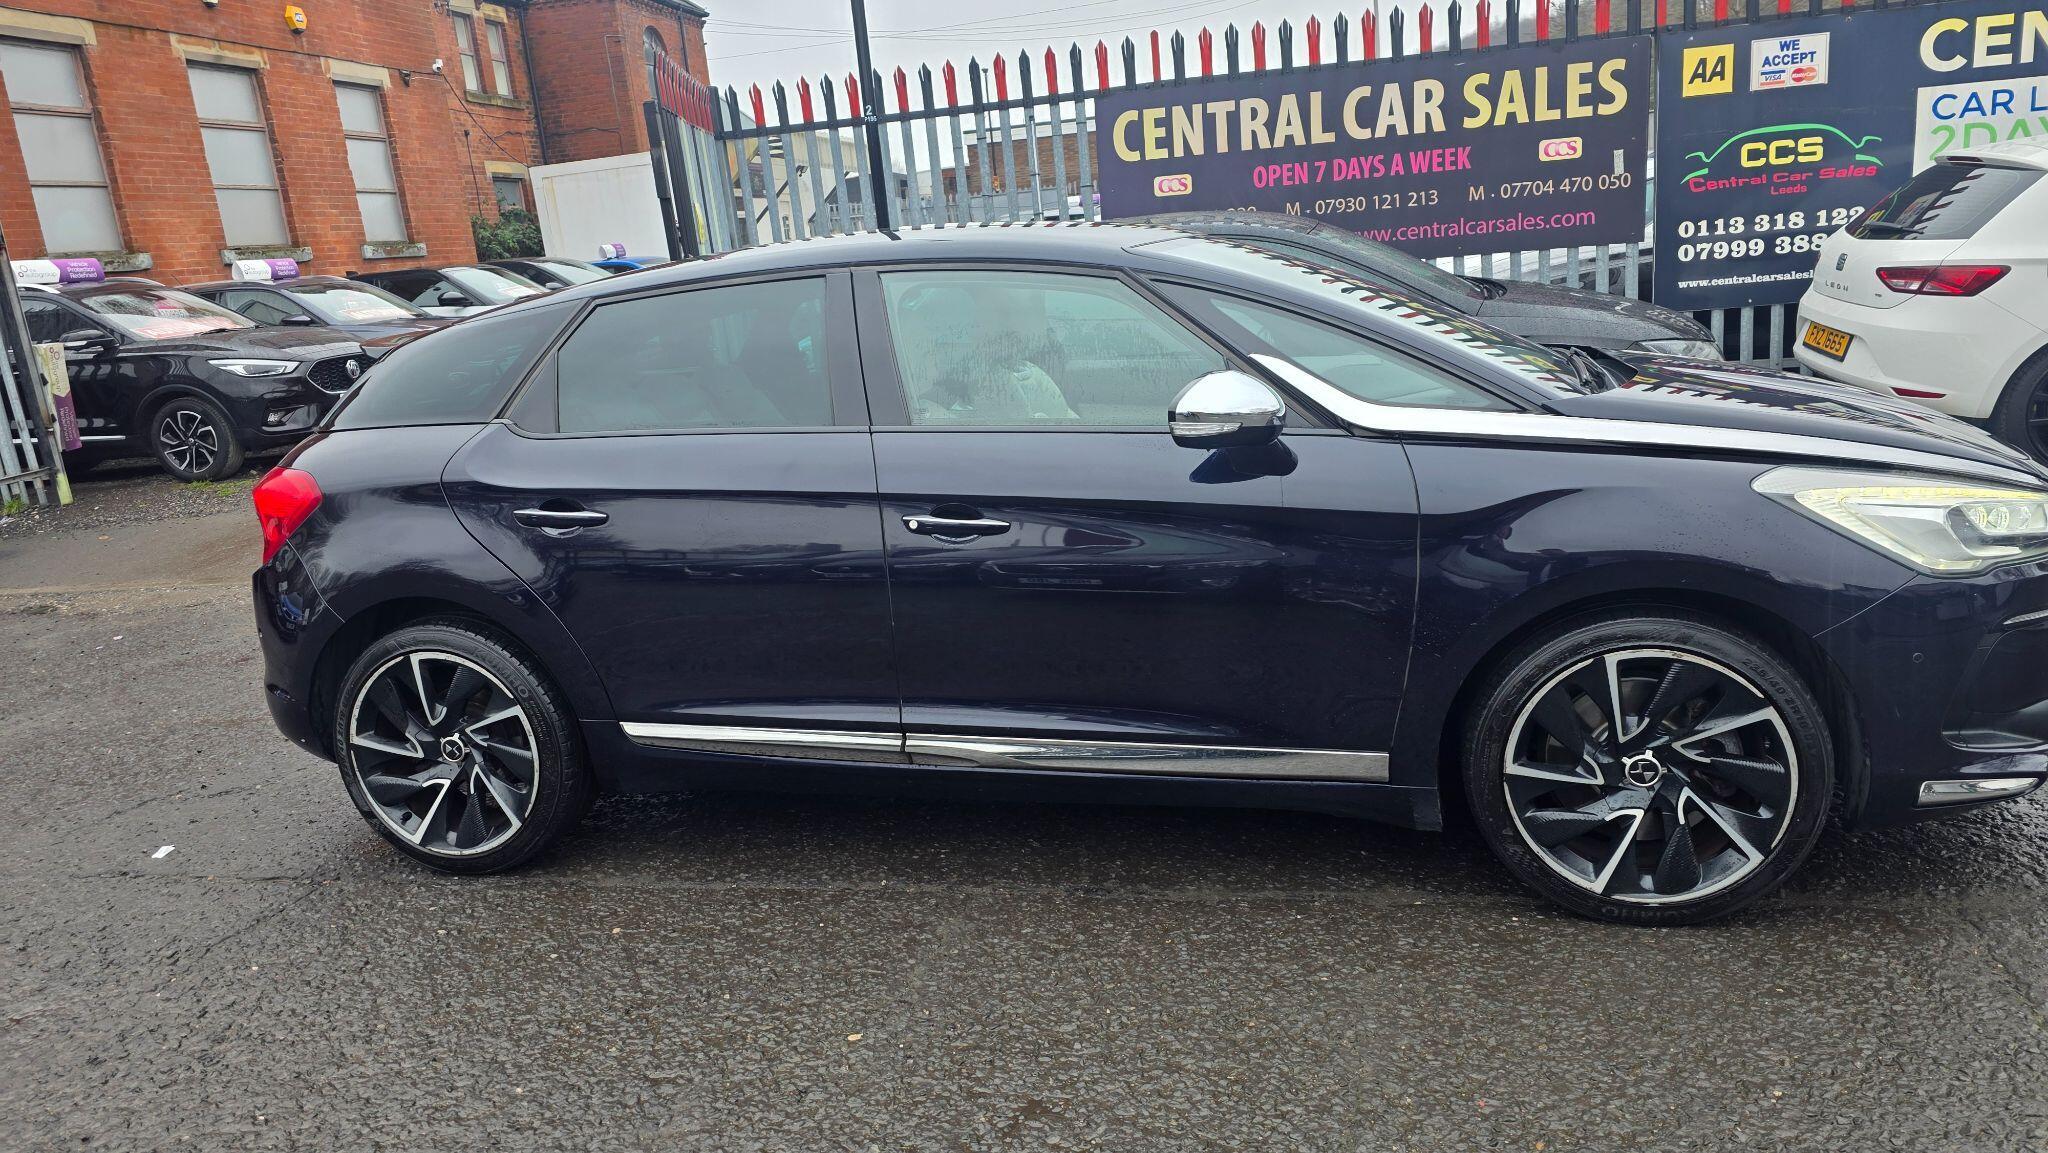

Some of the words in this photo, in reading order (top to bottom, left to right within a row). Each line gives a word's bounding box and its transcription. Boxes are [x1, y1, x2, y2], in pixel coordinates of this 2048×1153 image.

[1779, 39, 1800, 52] WE
[1920, 10, 2048, 72] CEN
[1688, 55, 1727, 85] AA
[1762, 51, 1816, 68] ACCEPT
[1764, 74, 1782, 82] VISA
[866, 105, 873, 115] 2
[1112, 91, 1336, 162] CENTRAL
[1343, 78, 1447, 140] CAR
[1462, 58, 1628, 129] SALES
[1931, 88, 2015, 121] CAR
[1740, 136, 1824, 168] CCS
[1253, 161, 1309, 189] OPEN
[1314, 160, 1327, 183] 7
[1333, 154, 1386, 182] DAYS
[1391, 153, 1405, 176] A
[1409, 146, 1472, 175] WEEK
[1688, 174, 1768, 193] Central
[1773, 171, 1813, 184] Car
[1819, 165, 1878, 180] Sales
[1500, 179, 1555, 200] 07704
[1559, 175, 1593, 194] 470
[1598, 172, 1632, 190] 050
[1770, 184, 1807, 195] Leeds
[1315, 197, 1366, 215] 07930
[1372, 193, 1400, 210] 121
[1407, 189, 1439, 208] 213
[1354, 211, 1596, 242] ww.centralcarsales.com
[1677, 216, 1745, 239] 0113
[1754, 211, 1805, 232] 318
[1677, 238, 1765, 262] 07999
